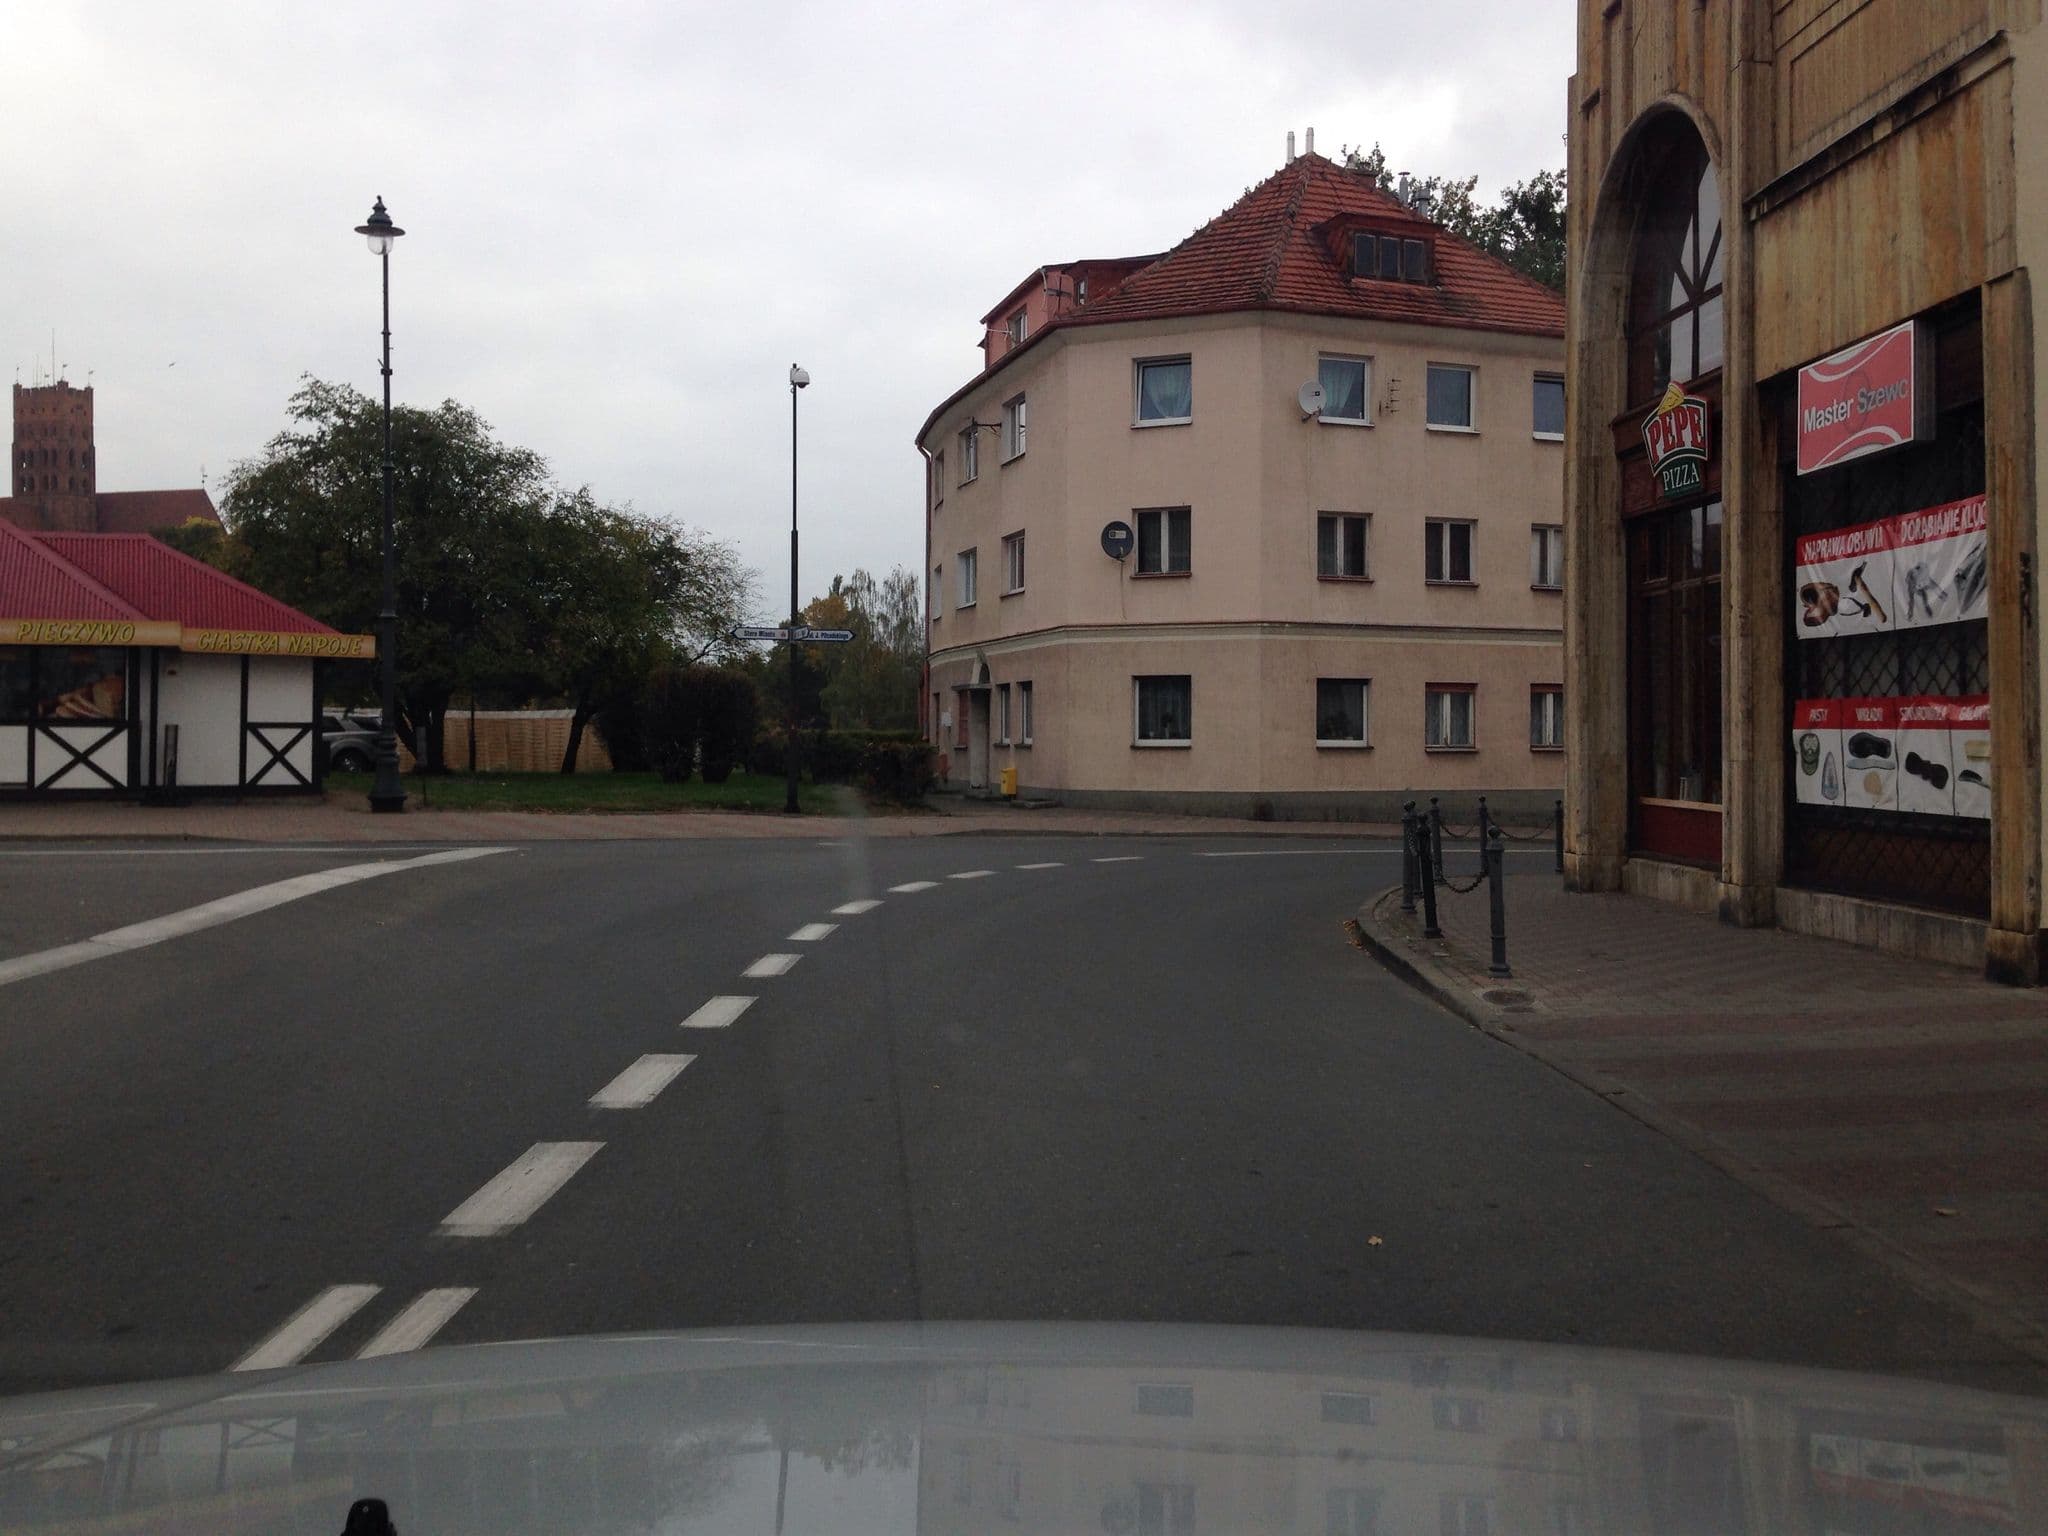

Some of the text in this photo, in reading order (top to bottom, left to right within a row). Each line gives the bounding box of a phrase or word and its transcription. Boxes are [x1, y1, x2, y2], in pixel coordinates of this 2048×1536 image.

[1804, 379, 1908, 433] Master Szewc
[1648, 405, 1705, 464] PEPE
[1663, 463, 1700, 491] PIZZA
[1900, 507, 1960, 544] DORABIANIE
[1804, 526, 1885, 561] NAPRAWA OBUWIA
[17, 622, 136, 643] PIECZYWO
[199, 631, 364, 656] CIASTKA NAPOJE
